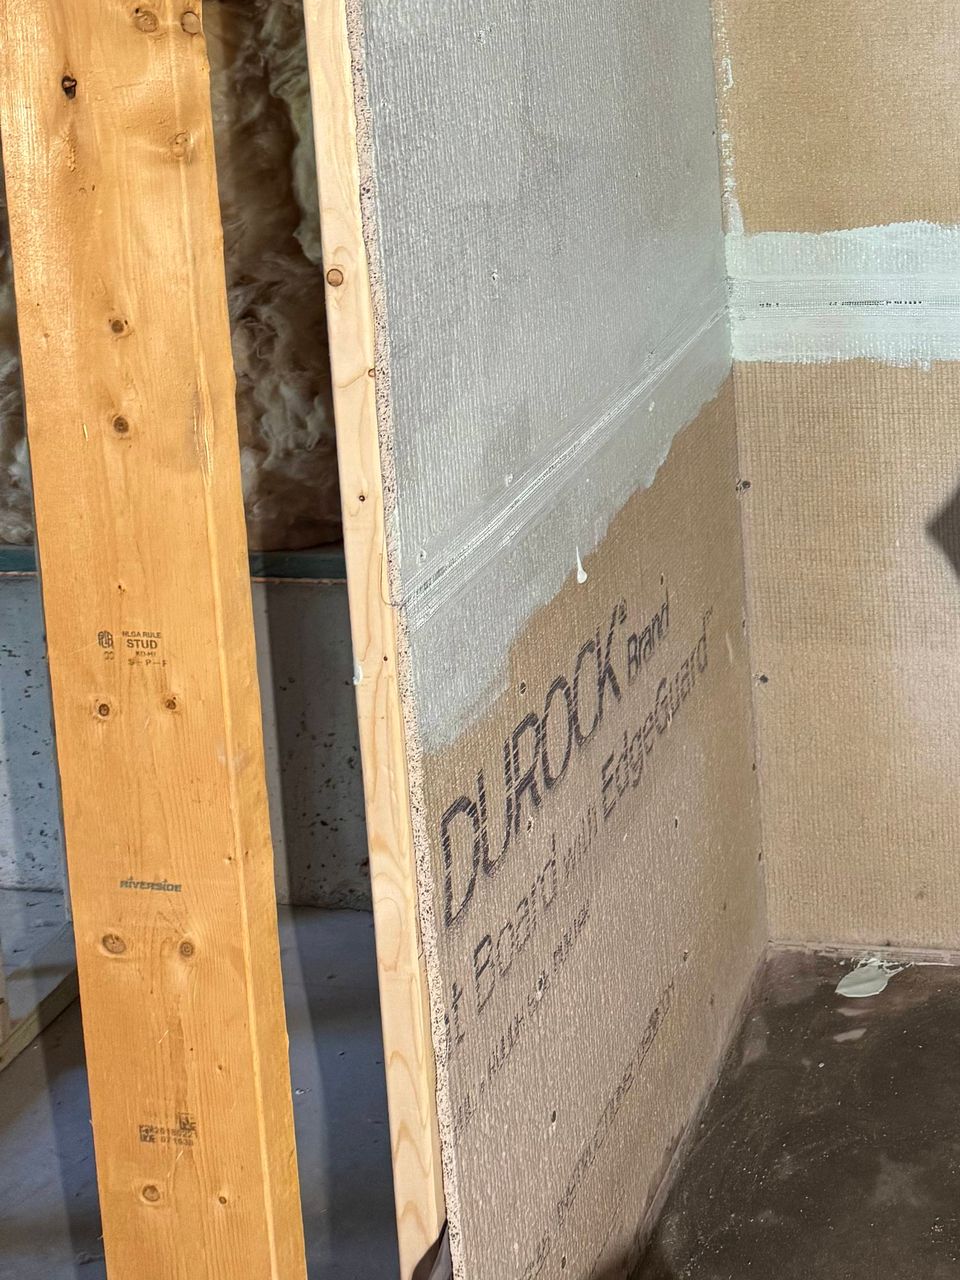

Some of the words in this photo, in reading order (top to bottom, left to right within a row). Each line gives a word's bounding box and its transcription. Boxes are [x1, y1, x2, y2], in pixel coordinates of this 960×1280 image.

[126, 638, 158, 650] STUD
[626, 589, 671, 683] Brand
[474, 833, 559, 1016] Board
